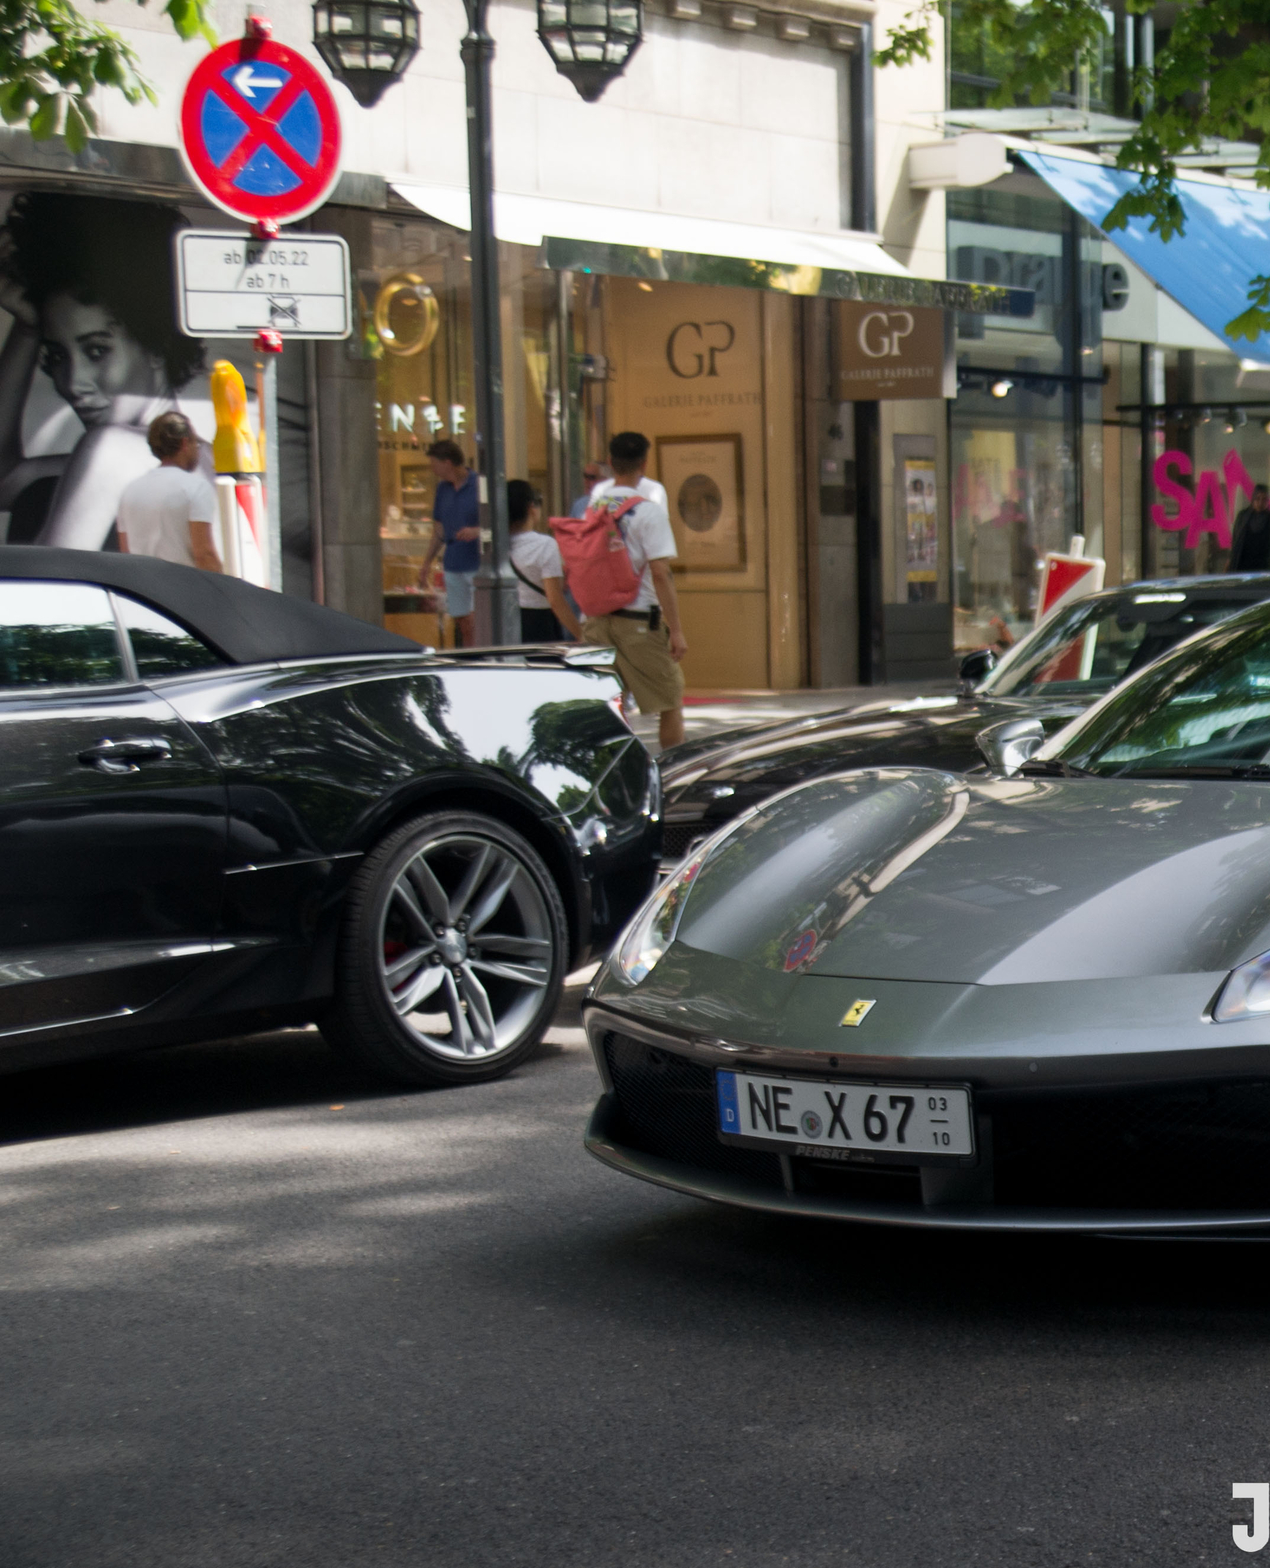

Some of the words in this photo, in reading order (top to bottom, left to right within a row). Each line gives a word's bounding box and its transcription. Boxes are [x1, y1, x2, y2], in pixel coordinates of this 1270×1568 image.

[223, 249, 242, 265] ab
[246, 273, 265, 289] ab
[267, 273, 277, 288] 7
[280, 273, 290, 289] h
[857, 310, 916, 358] GP
[664, 320, 736, 380] GP
[928, 1096, 948, 1111] 03
[726, 1108, 734, 1122] D
[748, 1082, 798, 1135] NE
[825, 1091, 852, 1140] X
[863, 1094, 915, 1144] 67
[932, 1132, 950, 1146] 10
